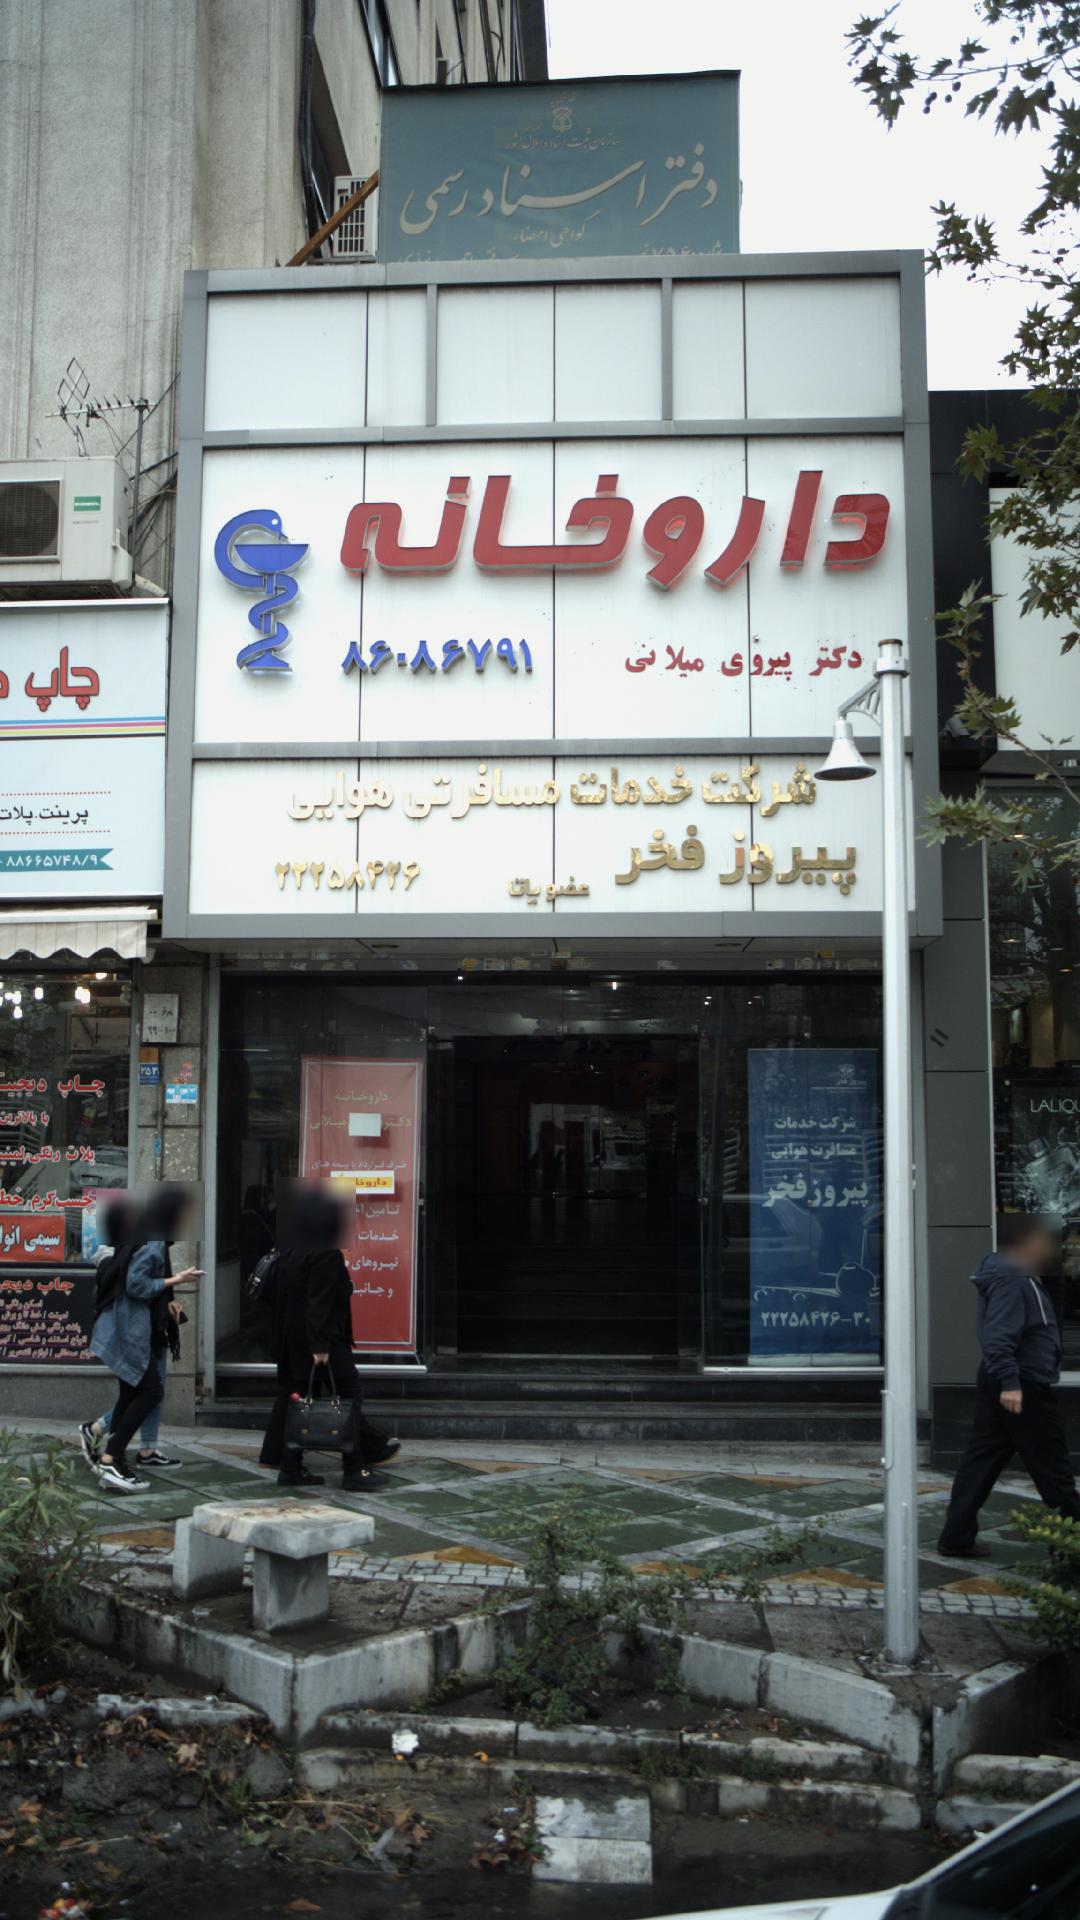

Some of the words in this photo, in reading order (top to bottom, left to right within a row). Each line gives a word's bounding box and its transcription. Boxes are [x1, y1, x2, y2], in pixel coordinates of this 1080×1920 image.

[478, 159, 647, 216] اسناد
[640, 142, 718, 227] دفتر
[399, 168, 468, 235] رسمی
[338, 469, 890, 592] داروخانه
[341, 637, 533, 676] ۸۶۰۸۶۷۹۱
[624, 643, 704, 675] میلانی
[720, 647, 793, 683] پیروی
[808, 645, 863, 678] دکتر
[25, 645, 100, 712] چاپ
[288, 771, 395, 821] هوایی
[404, 764, 562, 820] مسافرتی
[569, 765, 694, 805] خدمات
[702, 763, 817, 818] شرکت
[6, 854, 98, 867] ۸۸۶۶۵۷۴۸/۹
[615, 824, 706, 886] فخر
[719, 829, 857, 897] پیروز
[274, 859, 421, 892] ۲۲۲۵۸۴۲۶
[546, 875, 591, 903] عضو
[508, 876, 542, 907] یاتا
[0, 1072, 47, 1097] دیجیت
[58, 1074, 105, 1098] چاپ
[40, 1111, 50, 1127] با
[1030, 1099, 1080, 1114] LALIQ
[774, 1116, 817, 1130] خدمات
[818, 1116, 856, 1133] شرکت
[66, 1144, 95, 1166] پلات
[771, 1141, 808, 1161] هوایی
[810, 1141, 857, 1157] مسافرت
[355, 1177, 387, 1187] داروخا
[761, 1173, 808, 1208] فخر
[811, 1177, 869, 1208] پیروز
[0, 1224, 20, 1253] انوا
[23, 1233, 61, 1252] سیمی
[358, 1229, 399, 1242] خدمات
[351, 1256, 399, 1271] نیروهای
[37, 1276, 74, 1296] چاپ
